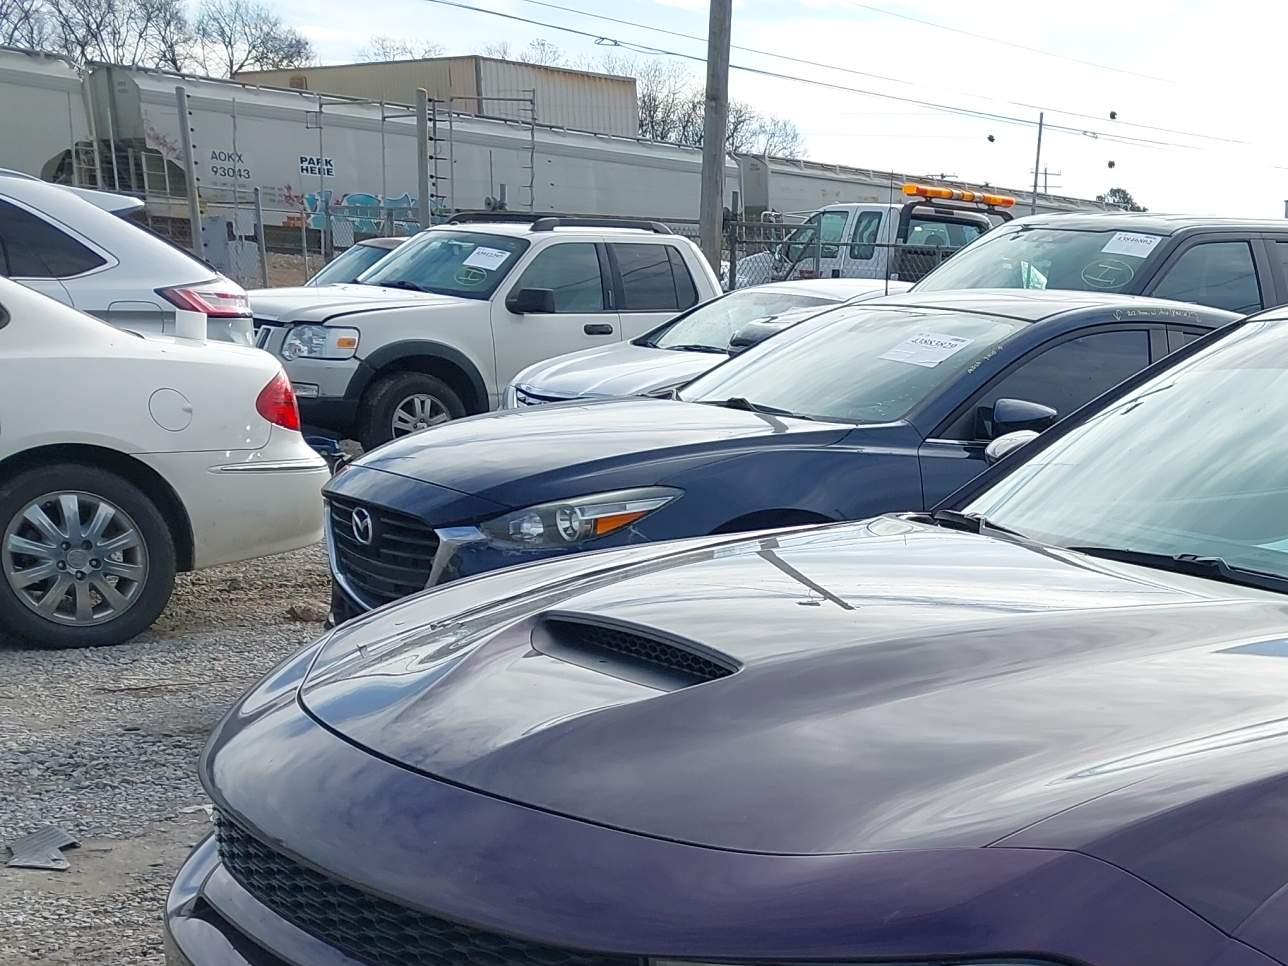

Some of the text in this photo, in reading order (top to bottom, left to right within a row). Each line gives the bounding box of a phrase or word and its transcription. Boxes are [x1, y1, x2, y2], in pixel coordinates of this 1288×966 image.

[210, 151, 244, 163] AOKX
[300, 156, 333, 167] PARK
[211, 166, 251, 179] 93043
[301, 166, 334, 176] HERE
